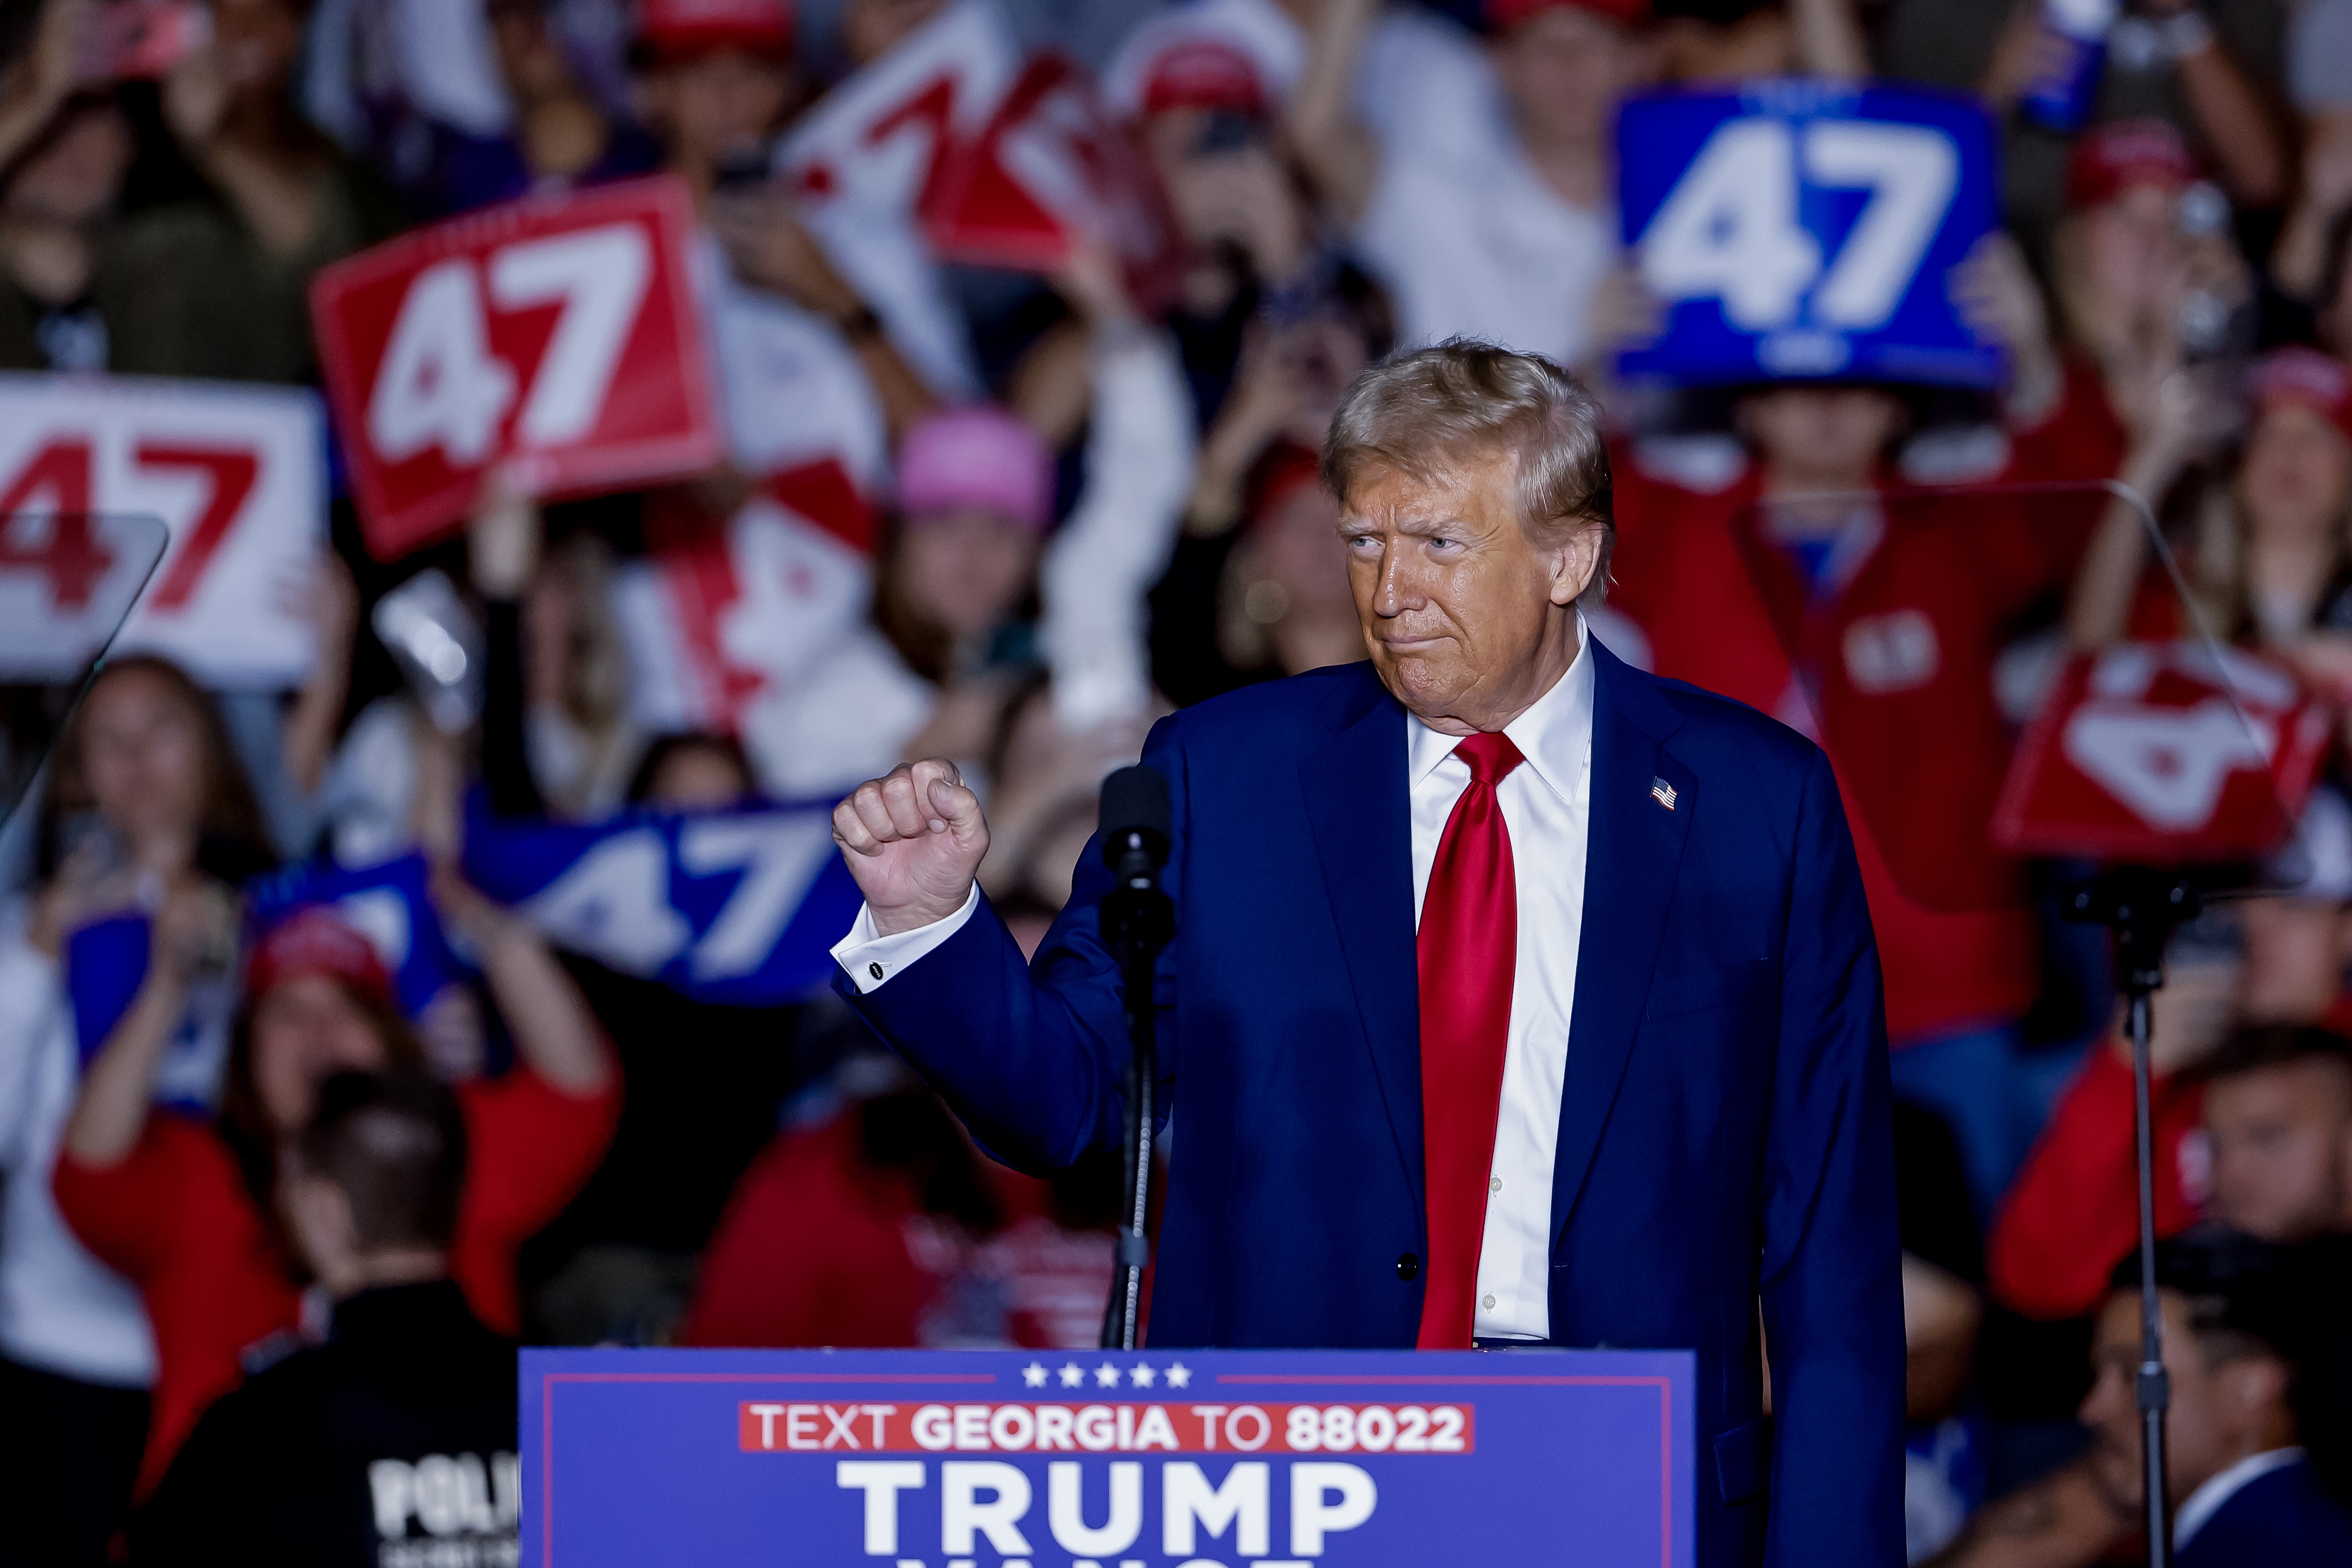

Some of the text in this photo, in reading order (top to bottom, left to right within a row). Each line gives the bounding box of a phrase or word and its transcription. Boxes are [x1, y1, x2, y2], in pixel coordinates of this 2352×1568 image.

[1640, 117, 1961, 331] 47
[368, 223, 652, 465] 47
[0, 436, 260, 609] 47
[512, 795, 839, 981] 47
[748, 1403, 1466, 1452] TEXT GEORGIA TO 88022
[835, 1459, 1378, 1558] TRUMP
